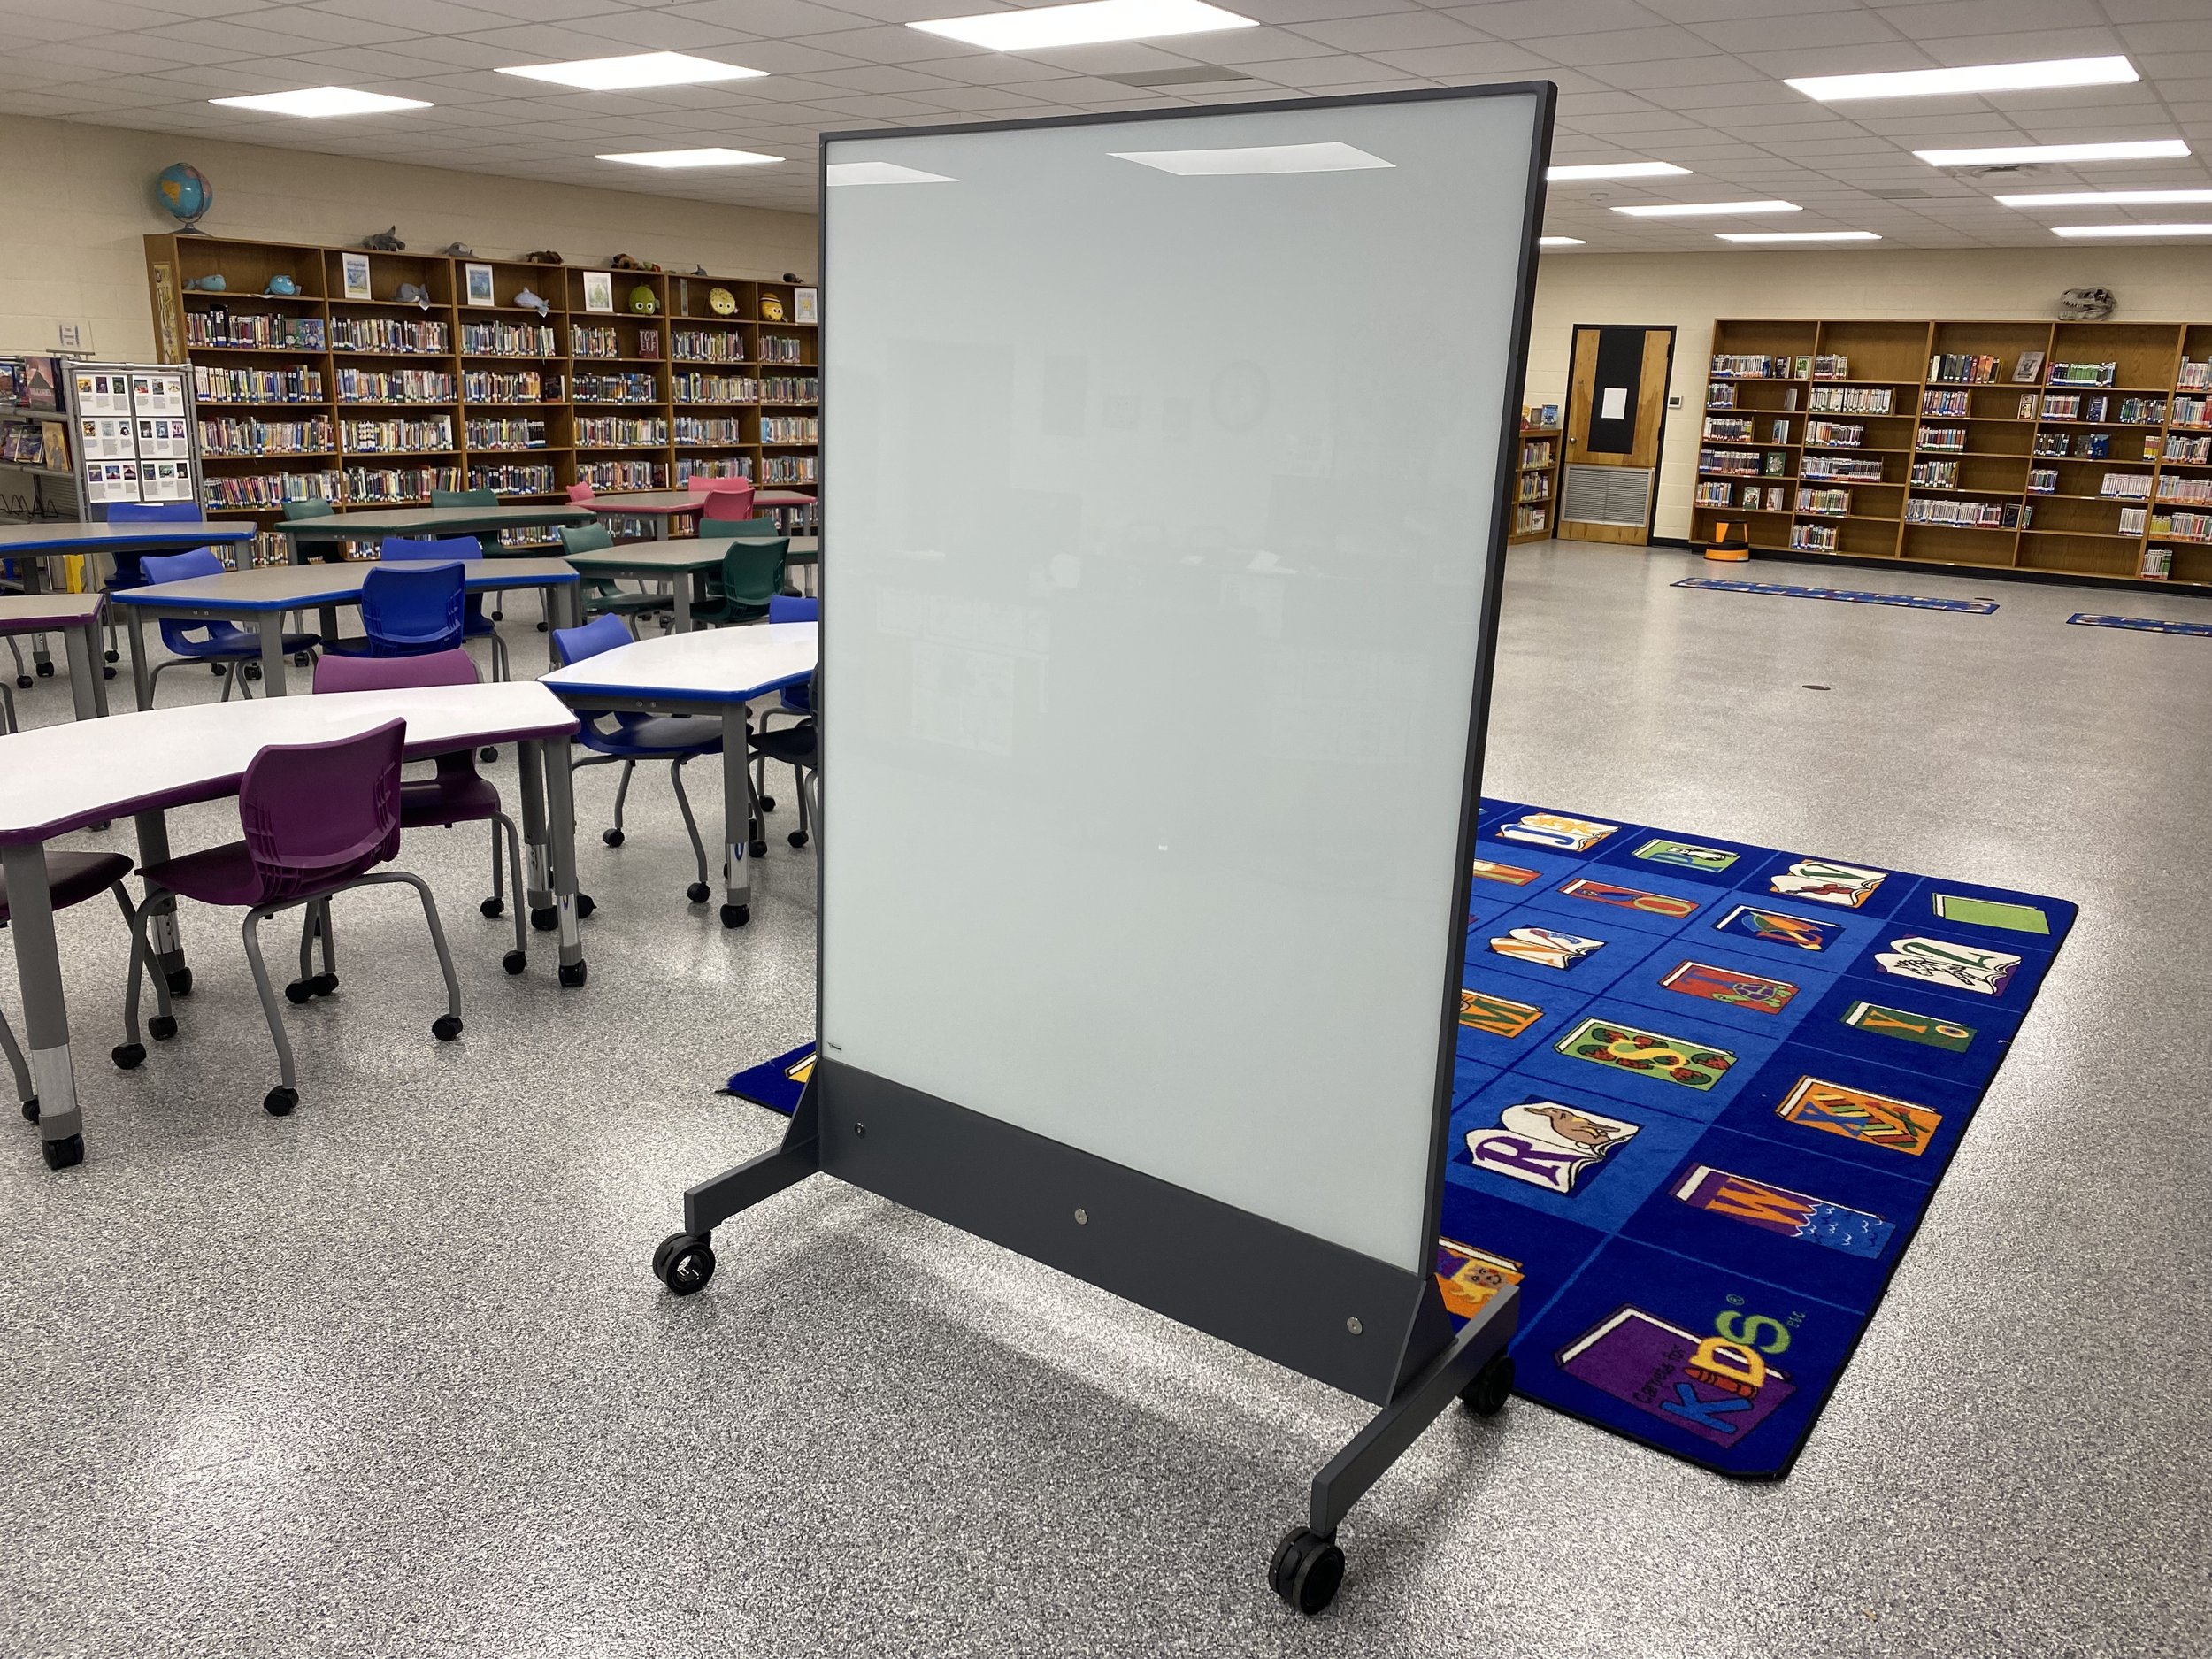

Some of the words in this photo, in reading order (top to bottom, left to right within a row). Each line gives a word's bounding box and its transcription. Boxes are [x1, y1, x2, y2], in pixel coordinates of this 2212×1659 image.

[639, 330, 656, 342] TOP
[1504, 824, 1575, 845] J
[1647, 852, 1724, 872] P
[1800, 864, 1868, 880] V
[1678, 968, 1733, 988] T
[1459, 998, 1537, 1033] M
[1862, 1010, 1928, 1034] Y
[1607, 1038, 1690, 1071] S
[1793, 1101, 1870, 1137] X
[1475, 1136, 1586, 1186] R
[1704, 1177, 1812, 1225] W
[1660, 1310, 1792, 1434] KIDS
